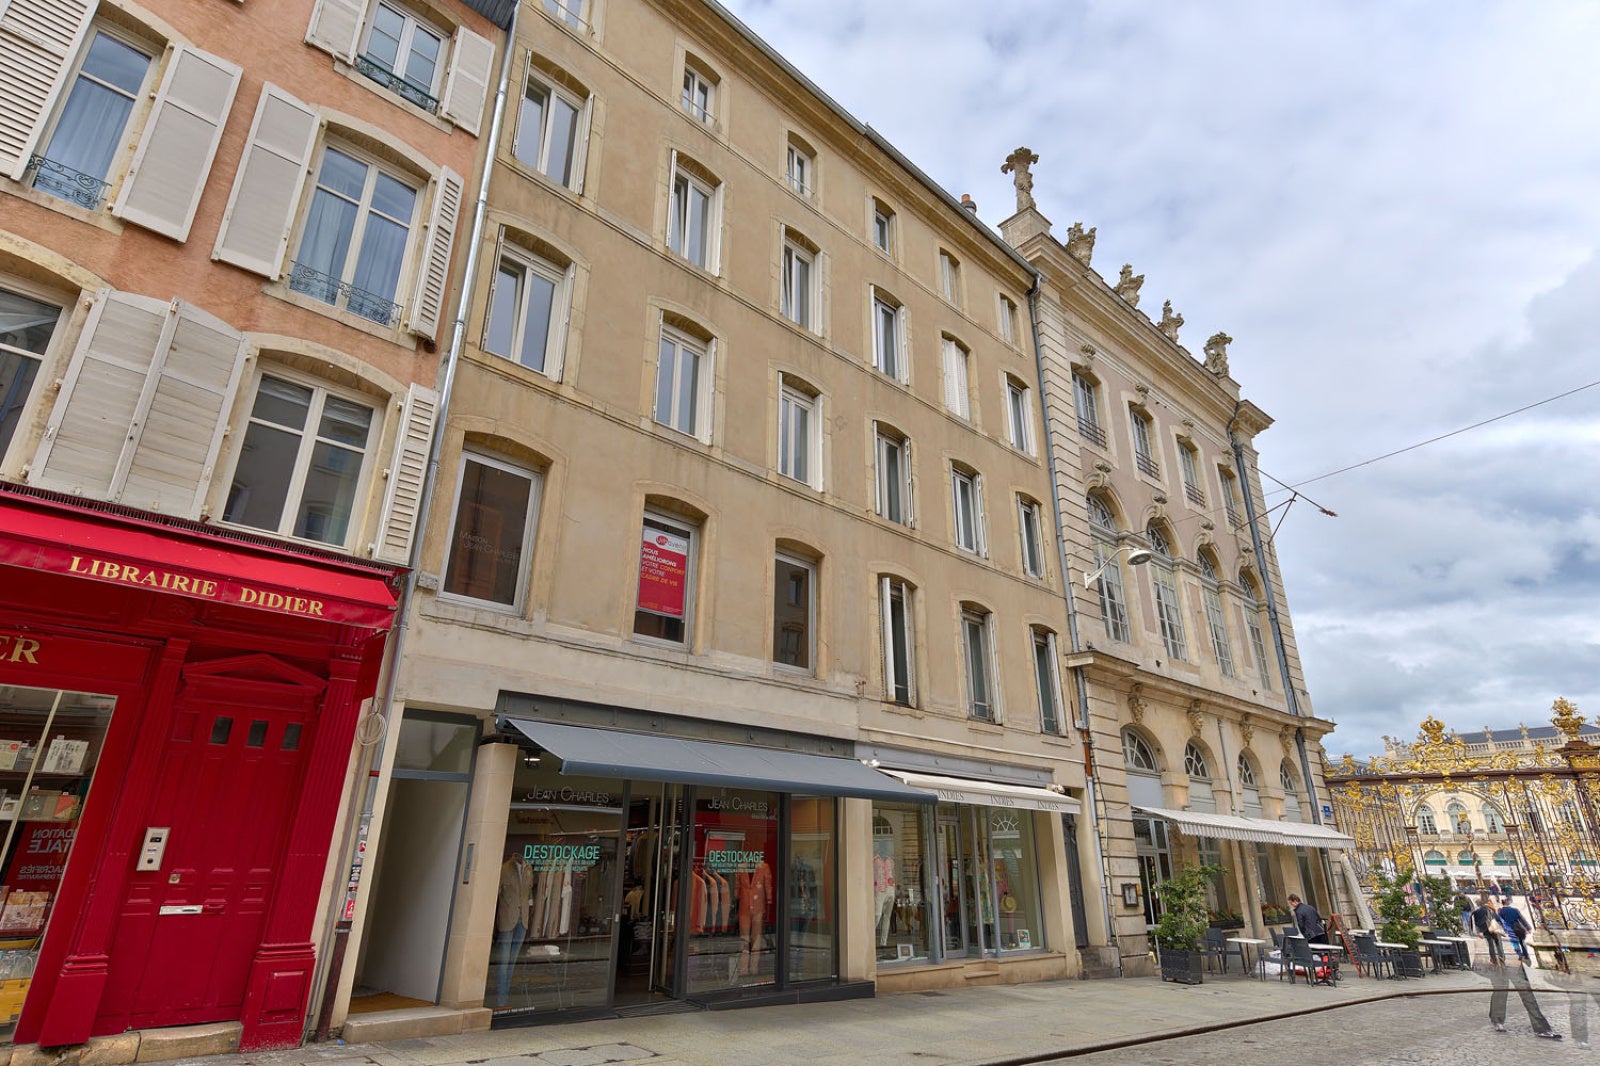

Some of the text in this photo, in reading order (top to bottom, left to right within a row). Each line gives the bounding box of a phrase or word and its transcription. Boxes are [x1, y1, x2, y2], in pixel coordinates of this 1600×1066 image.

[68, 555, 324, 616] LIBRAIRIE DIDIER
[527, 784, 609, 803] JEAN CHARLES
[707, 796, 768, 812] JEAN CHARLES
[523, 845, 600, 860] DESTOCKAGE
[709, 850, 765, 863] DESTOCKAGE
